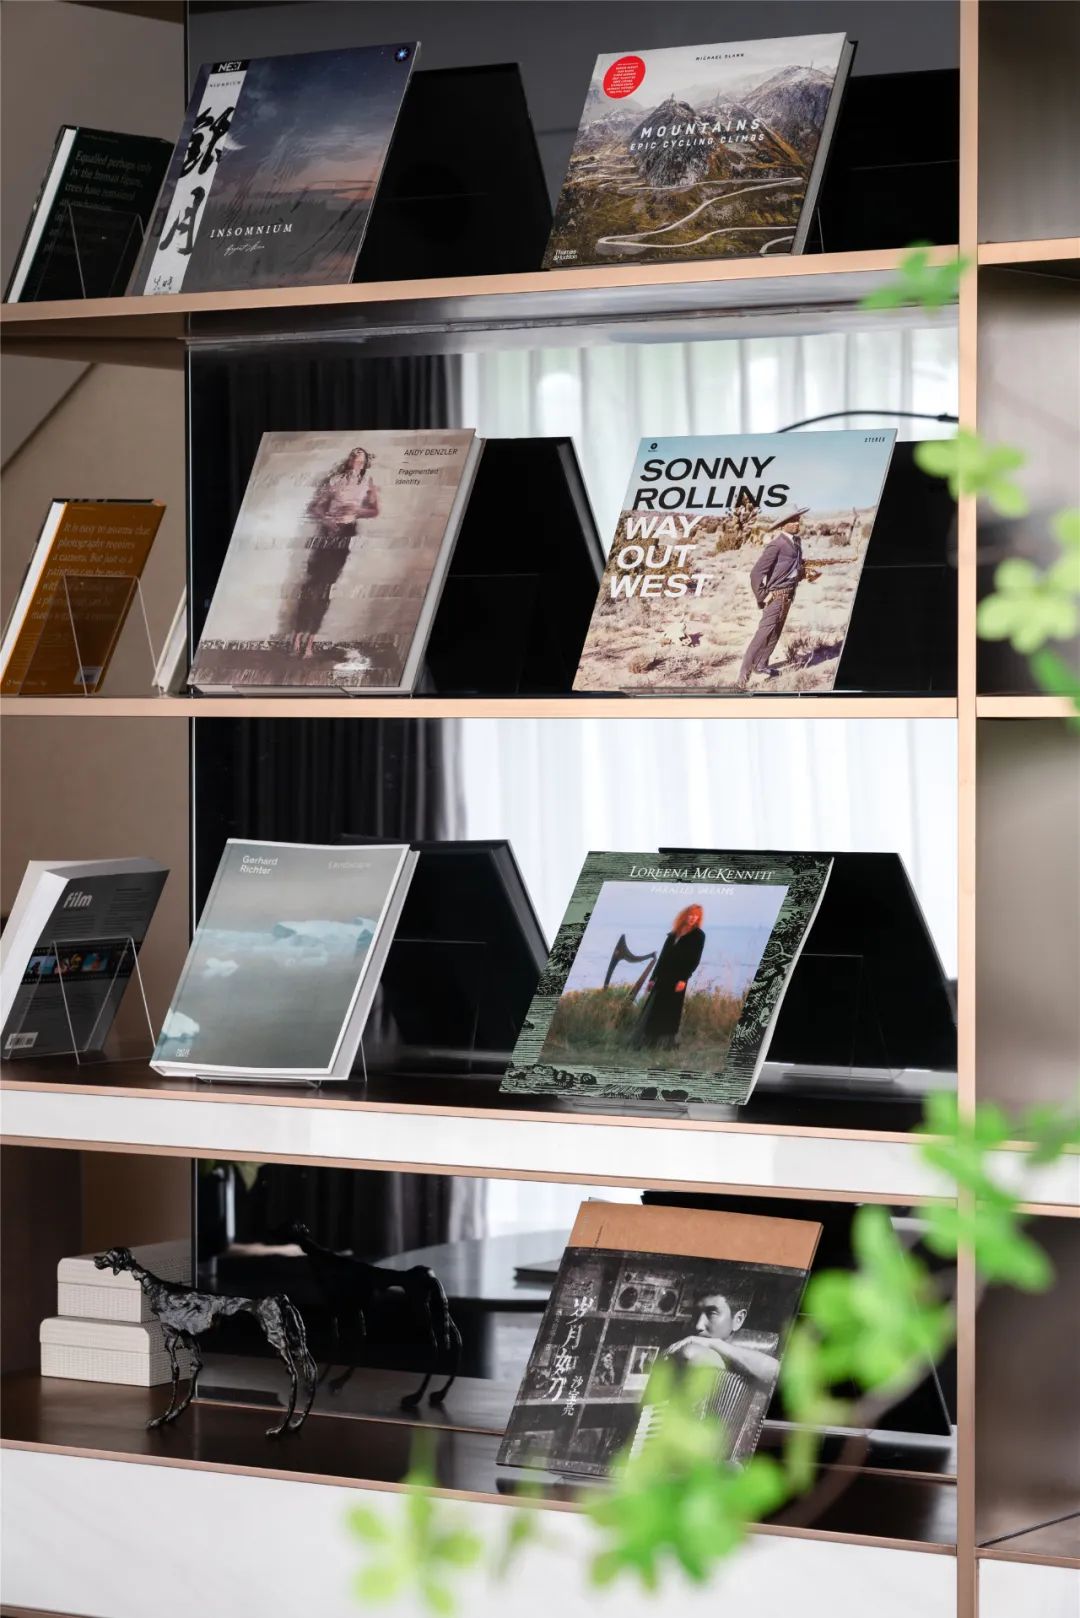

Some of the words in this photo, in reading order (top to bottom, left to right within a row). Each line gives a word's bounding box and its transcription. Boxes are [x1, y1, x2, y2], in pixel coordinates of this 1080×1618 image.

[640, 119, 761, 139] MOUNTAINS
[630, 142, 657, 151] EPIC
[663, 138, 714, 149] CYCLING
[720, 133, 765, 144] CLIMBS
[209, 223, 293, 239] INSOMNIUM
[425, 448, 458, 456] DENZLER
[398, 468, 439, 476] Fragmented
[639, 455, 777, 482] SONNY
[632, 484, 791, 511] ROLLINS
[625, 515, 702, 541] WAY
[616, 544, 697, 569] OUT
[610, 574, 714, 599] WEST
[239, 864, 273, 875] Richter
[242, 855, 279, 866] Gerhard
[629, 865, 689, 880] LOREENA
[63, 891, 93, 908] film
[541, 1296, 597, 1402] 岁月如刀
